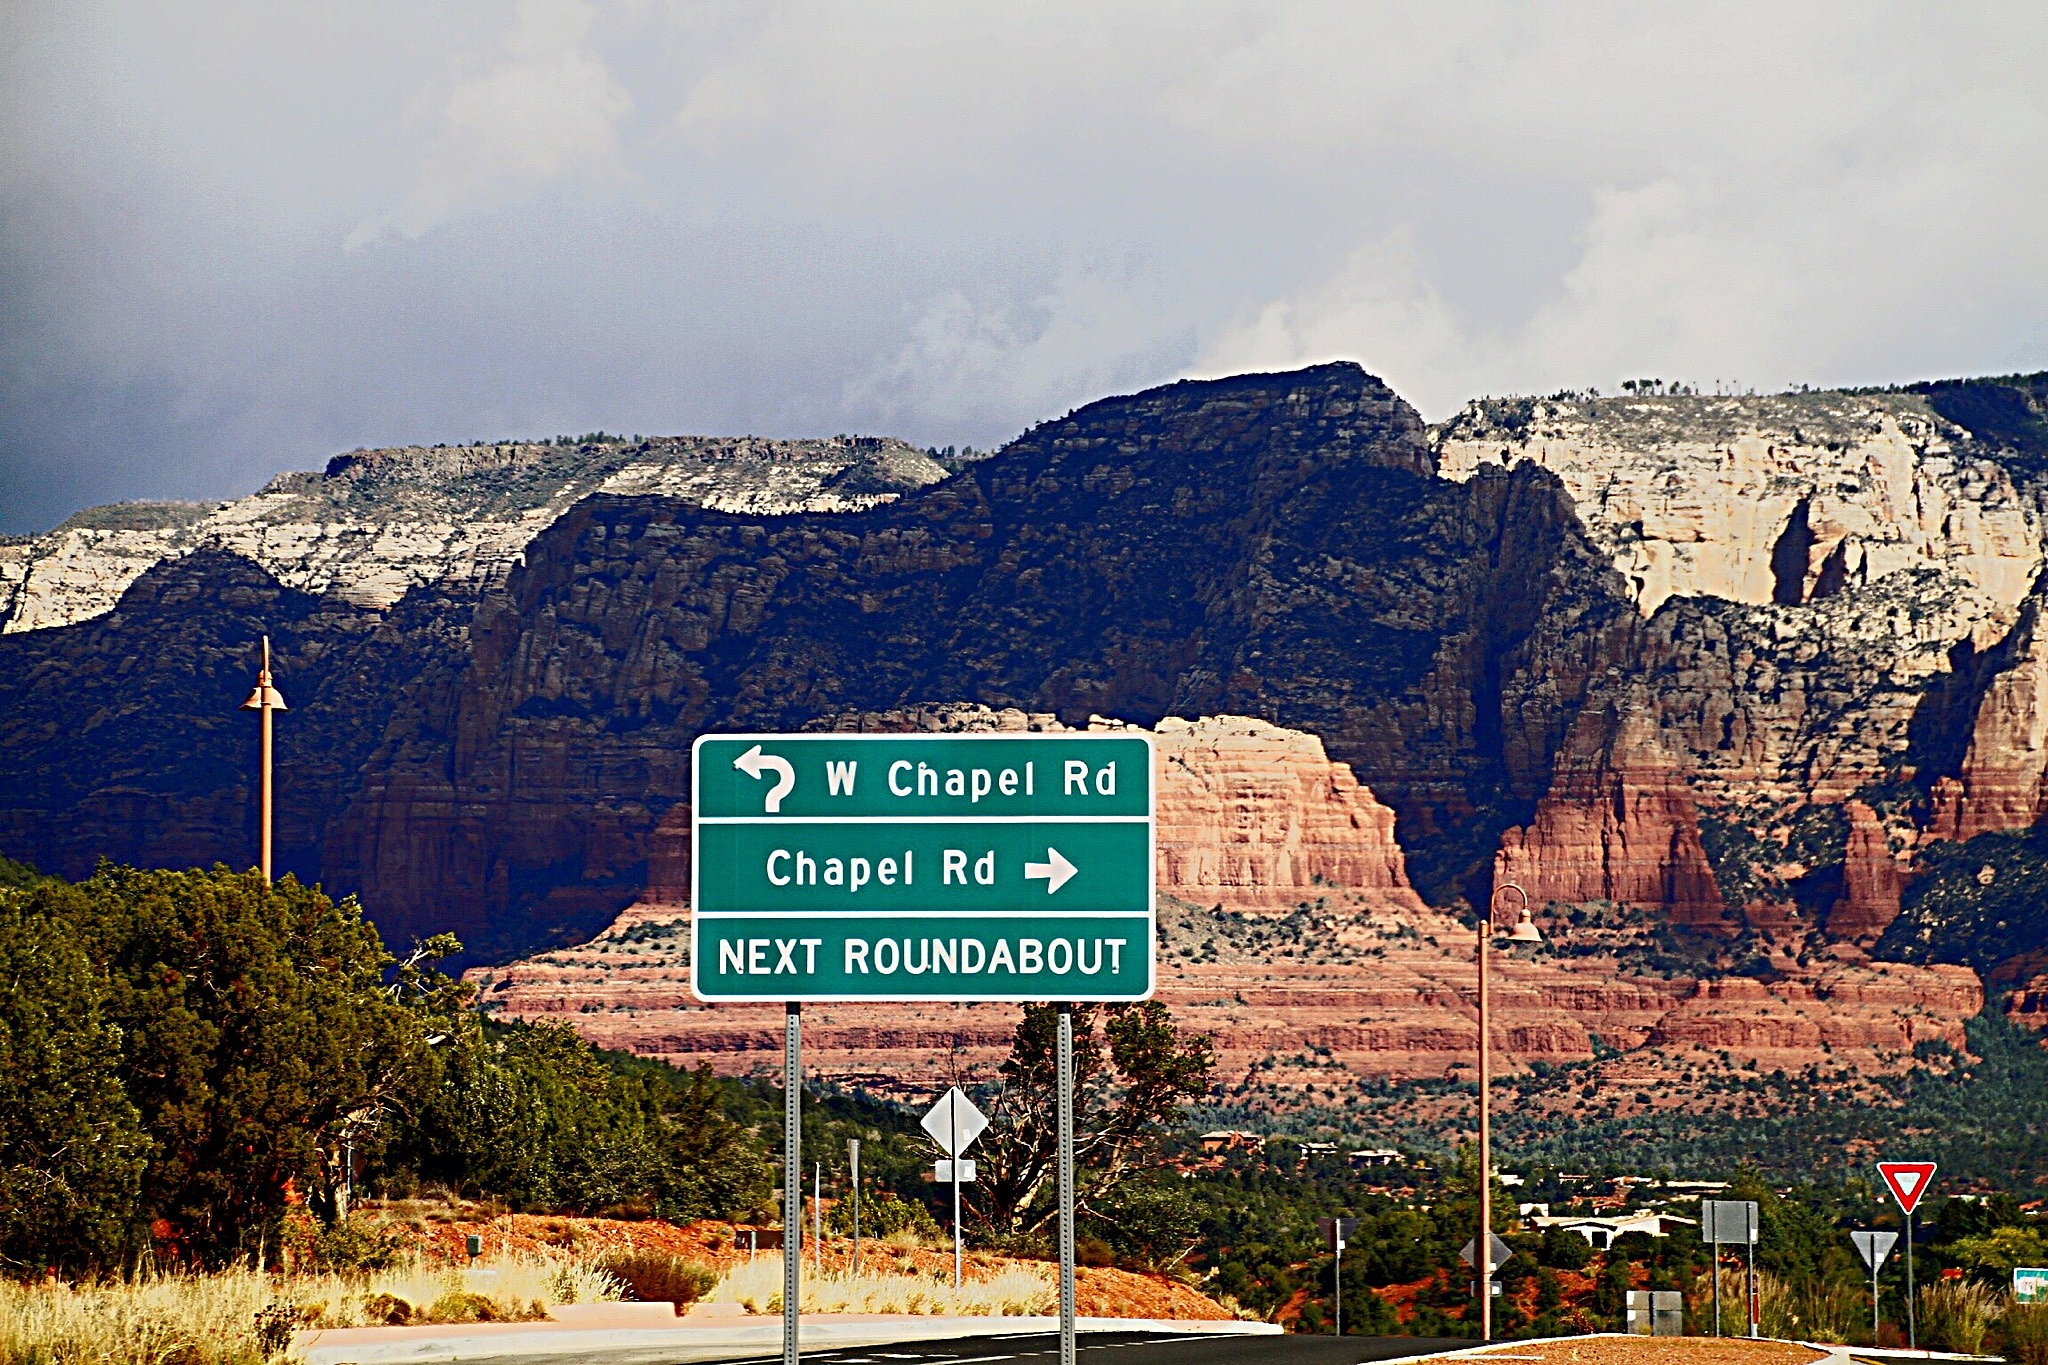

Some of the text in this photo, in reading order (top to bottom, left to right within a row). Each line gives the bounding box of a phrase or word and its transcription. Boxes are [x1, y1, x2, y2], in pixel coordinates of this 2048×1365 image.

[826, 760, 1116, 803] W Chapel Rd
[766, 849, 995, 893] Chapel Rd
[719, 937, 1127, 975] NEXT ROUNDABOUT
